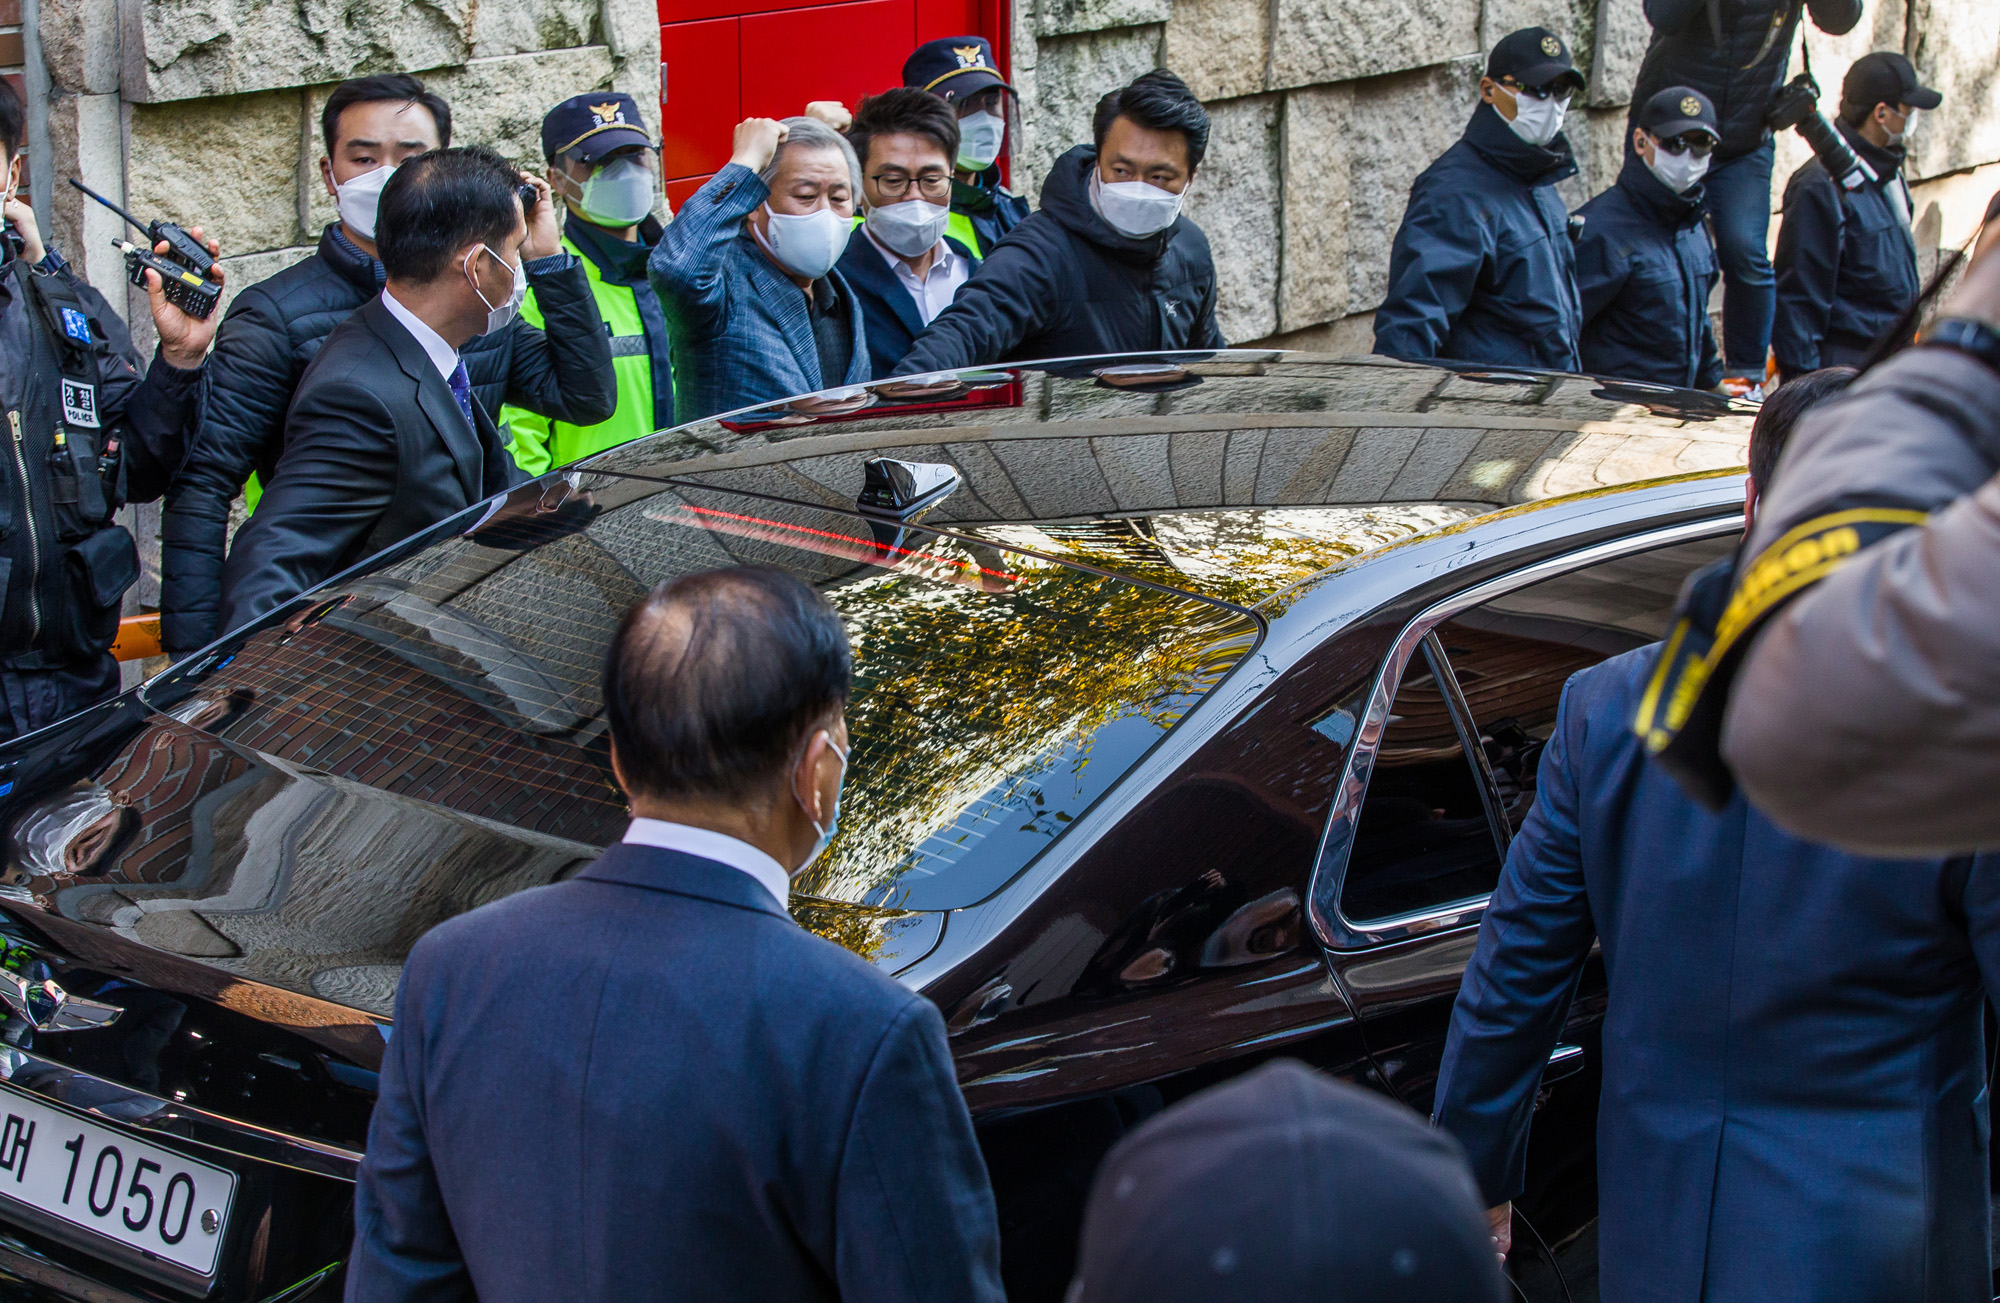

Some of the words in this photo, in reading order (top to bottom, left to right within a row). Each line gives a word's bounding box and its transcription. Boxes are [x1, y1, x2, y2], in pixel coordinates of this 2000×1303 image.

[65, 385, 91, 409] 경찰
[68, 409, 94, 423] POLICE
[62, 1133, 196, 1245] 1050
